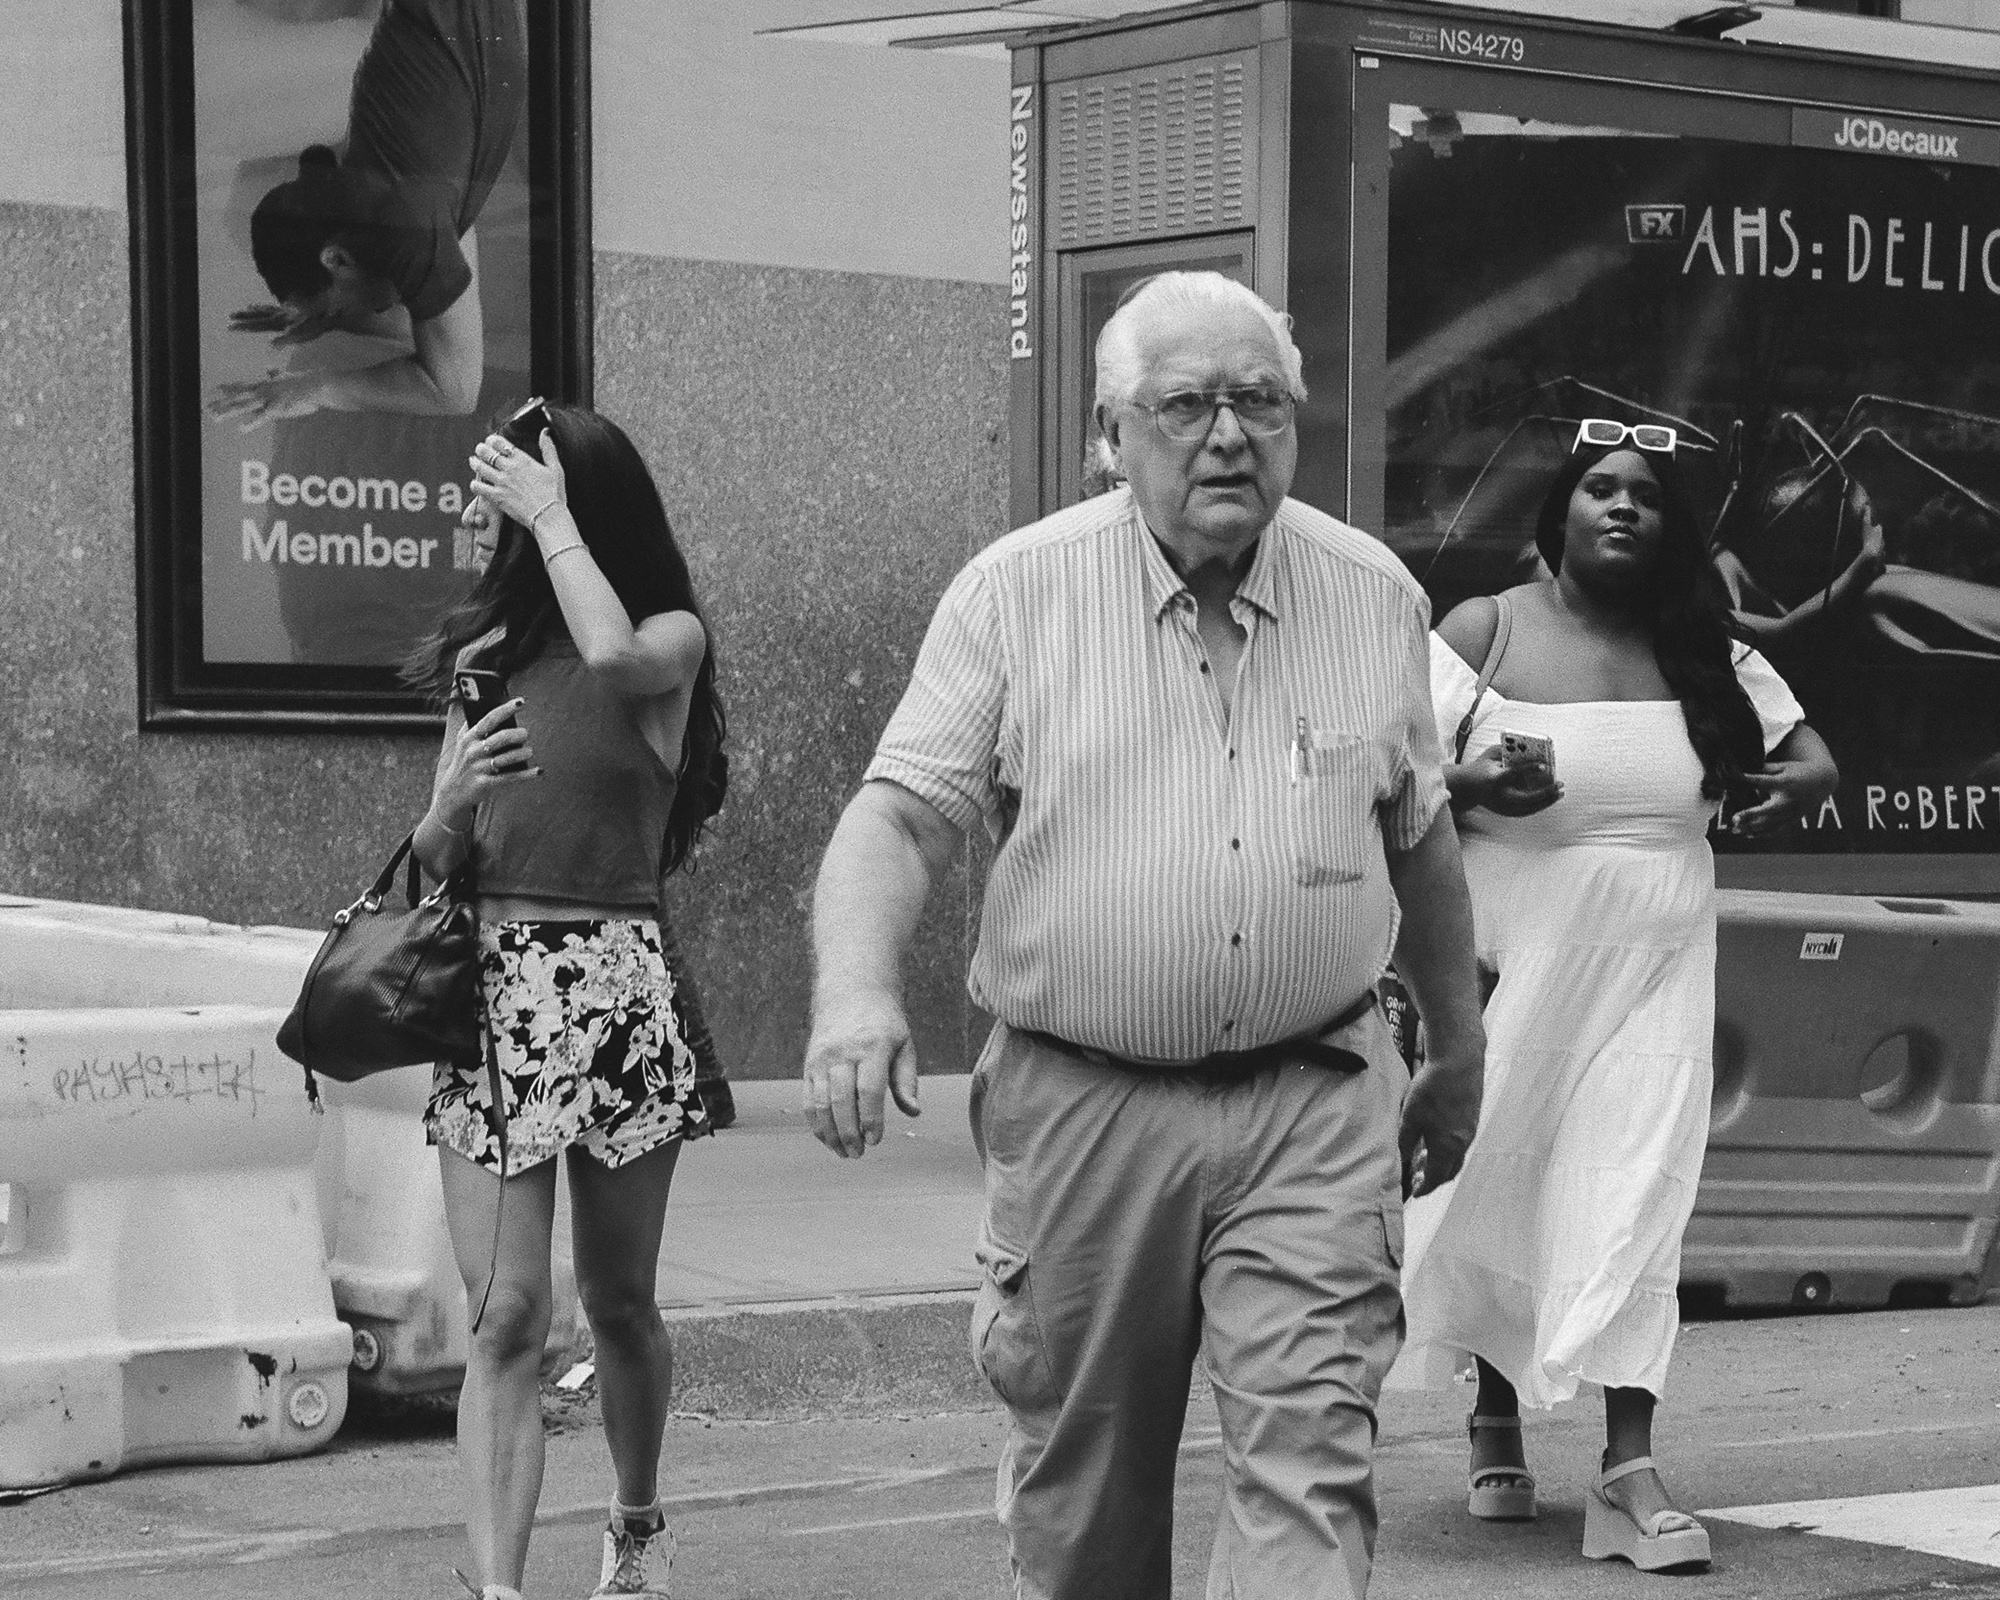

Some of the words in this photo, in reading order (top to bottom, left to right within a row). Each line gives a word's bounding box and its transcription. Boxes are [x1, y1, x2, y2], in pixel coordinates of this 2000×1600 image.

[1440, 28, 1524, 61] NS4279
[1834, 117, 1959, 158] JCDecaux
[1011, 85, 1033, 360] Newsstand
[1639, 212, 1675, 236] FX
[1682, 205, 1823, 280] AHS:
[241, 459, 428, 512] Become
[437, 481, 463, 514] a
[242, 518, 439, 568] Member
